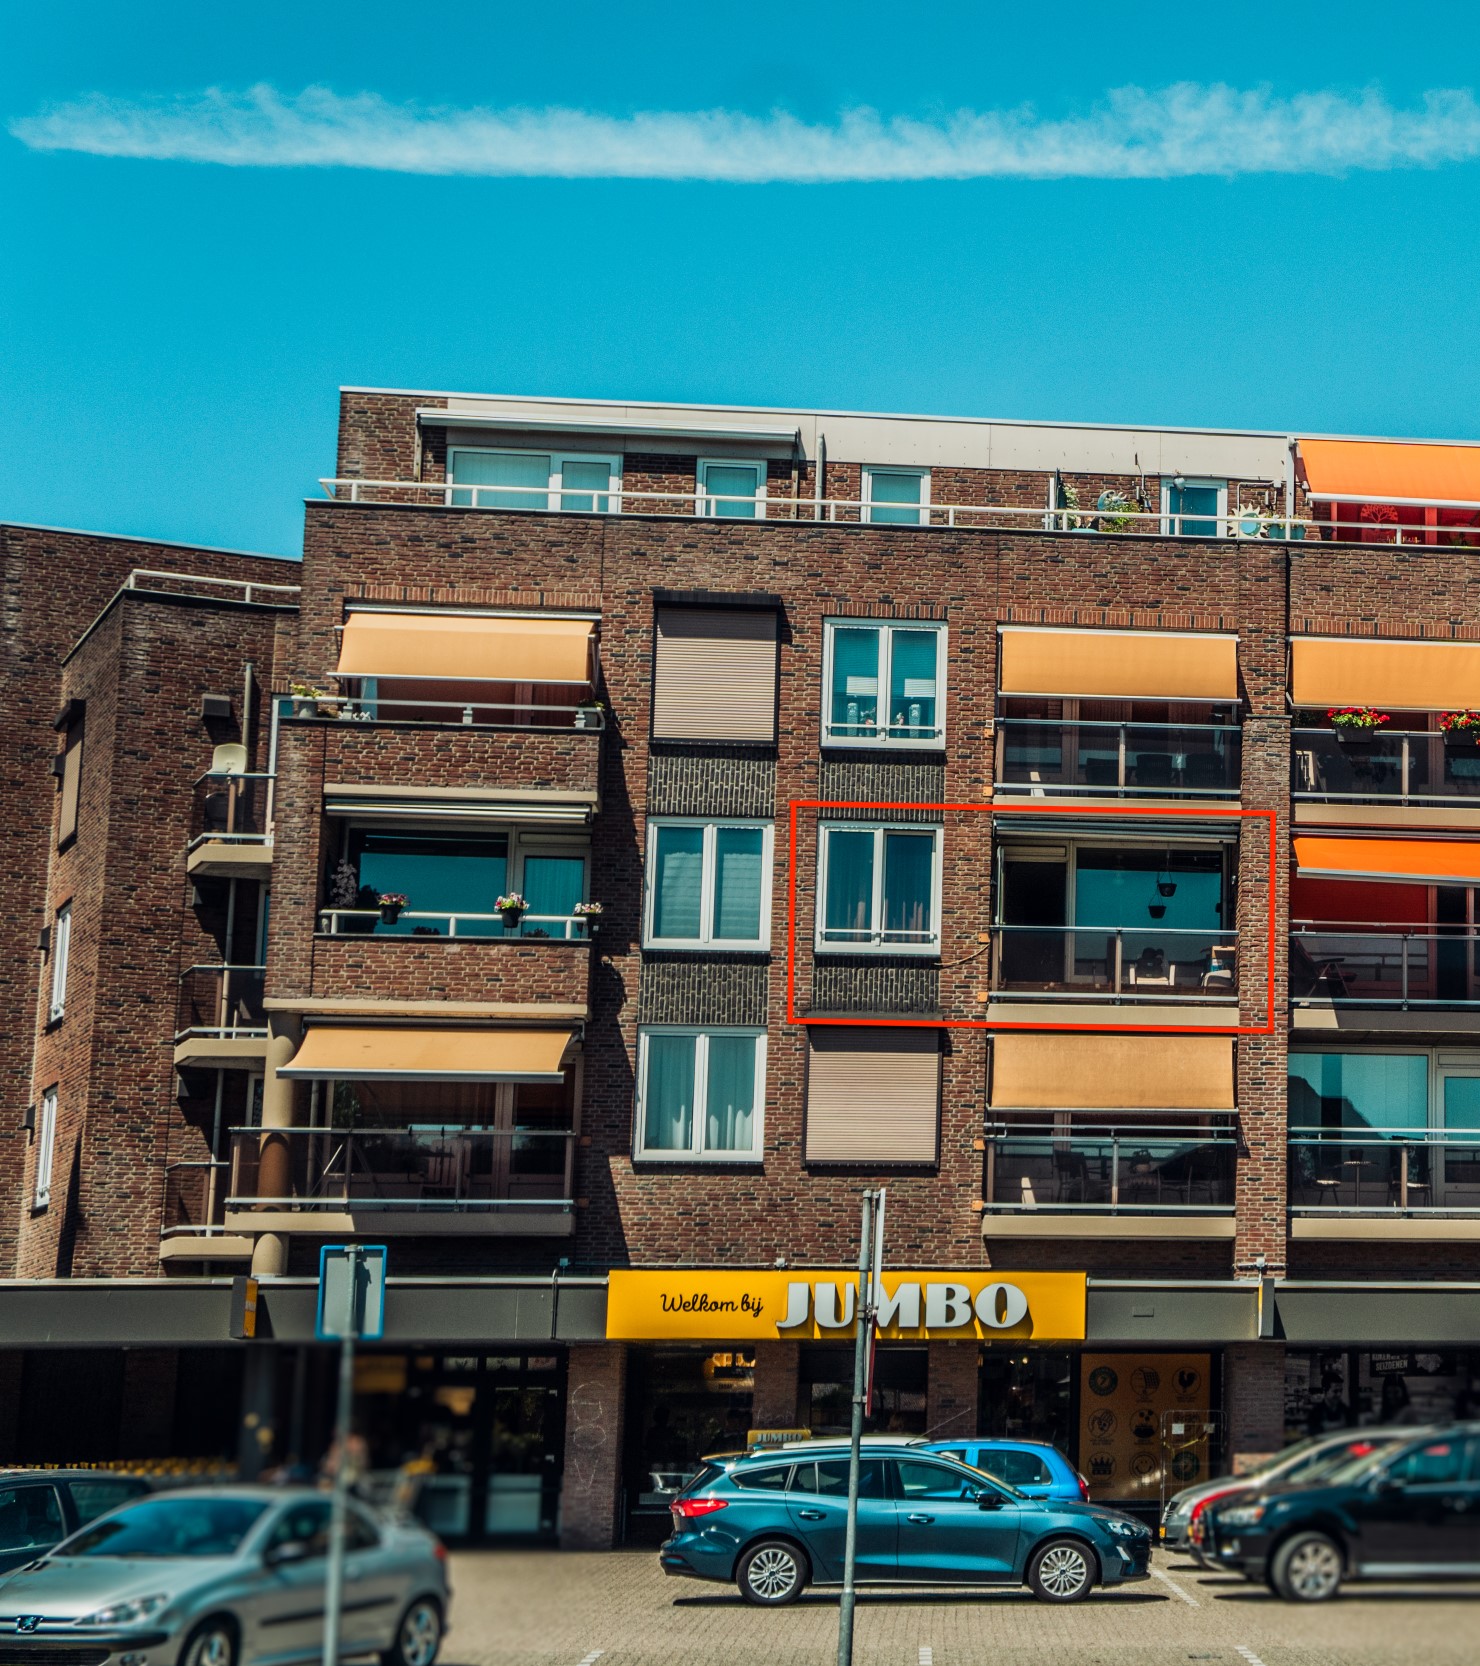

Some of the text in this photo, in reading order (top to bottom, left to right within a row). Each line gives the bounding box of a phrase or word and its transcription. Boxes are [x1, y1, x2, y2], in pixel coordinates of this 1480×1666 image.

[660, 1282, 1028, 1328] Welkom bij JUMBO
[757, 1432, 803, 1443] JUMBO
